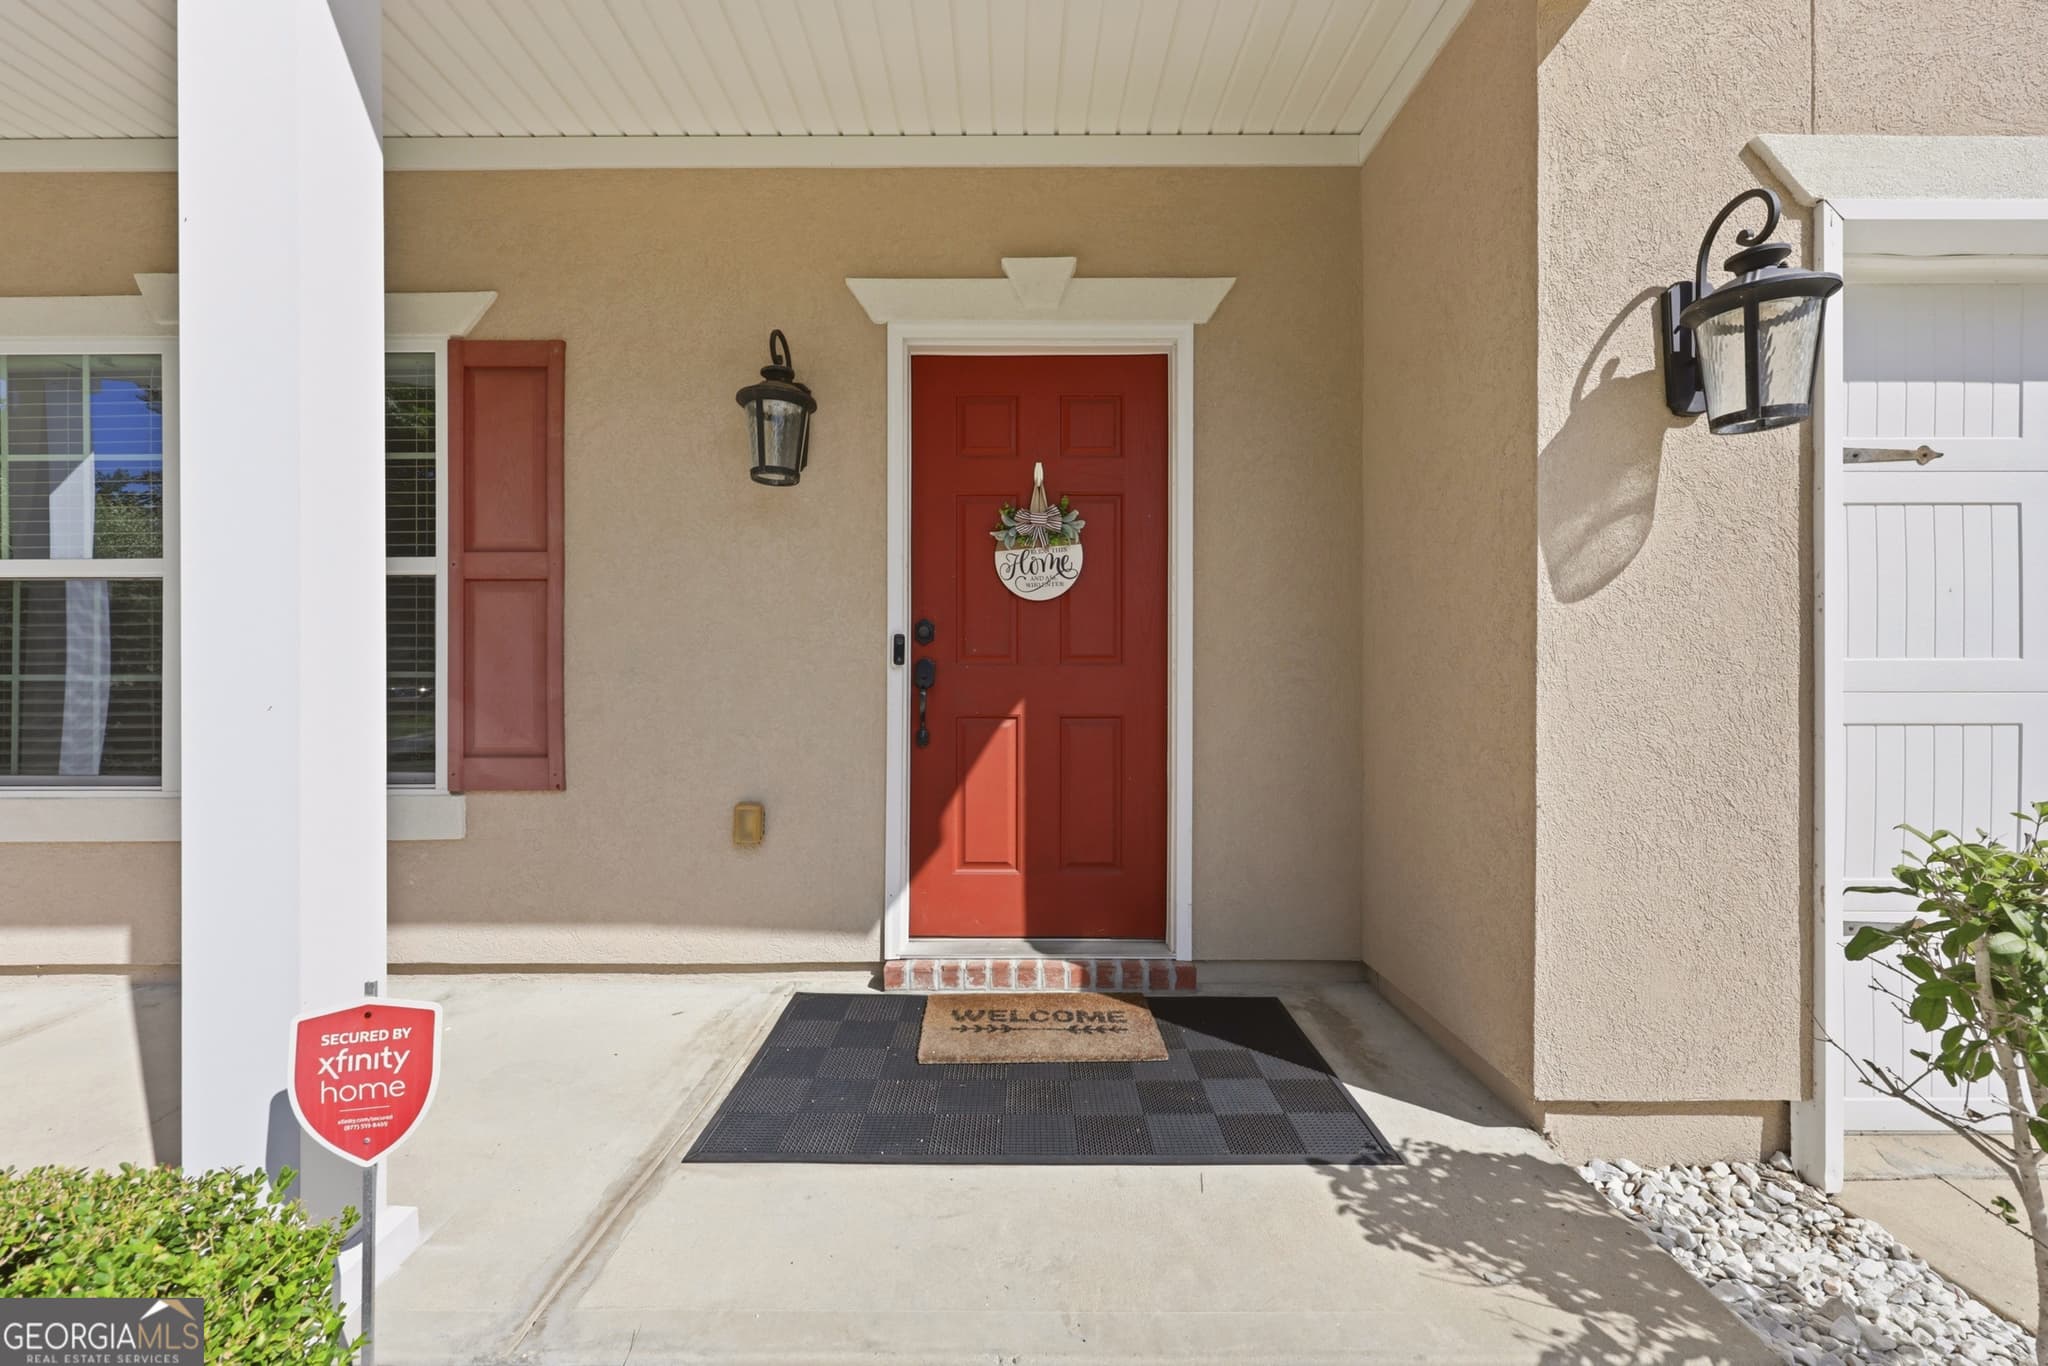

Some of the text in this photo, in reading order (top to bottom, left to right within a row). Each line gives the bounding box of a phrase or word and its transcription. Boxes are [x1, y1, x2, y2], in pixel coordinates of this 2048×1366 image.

[1000, 549, 1078, 592] Home
[951, 1009, 1128, 1023] WELCOME
[321, 1027, 412, 1046] SECURED BY
[317, 1046, 410, 1080] xfinity
[320, 1080, 406, 1104] home
